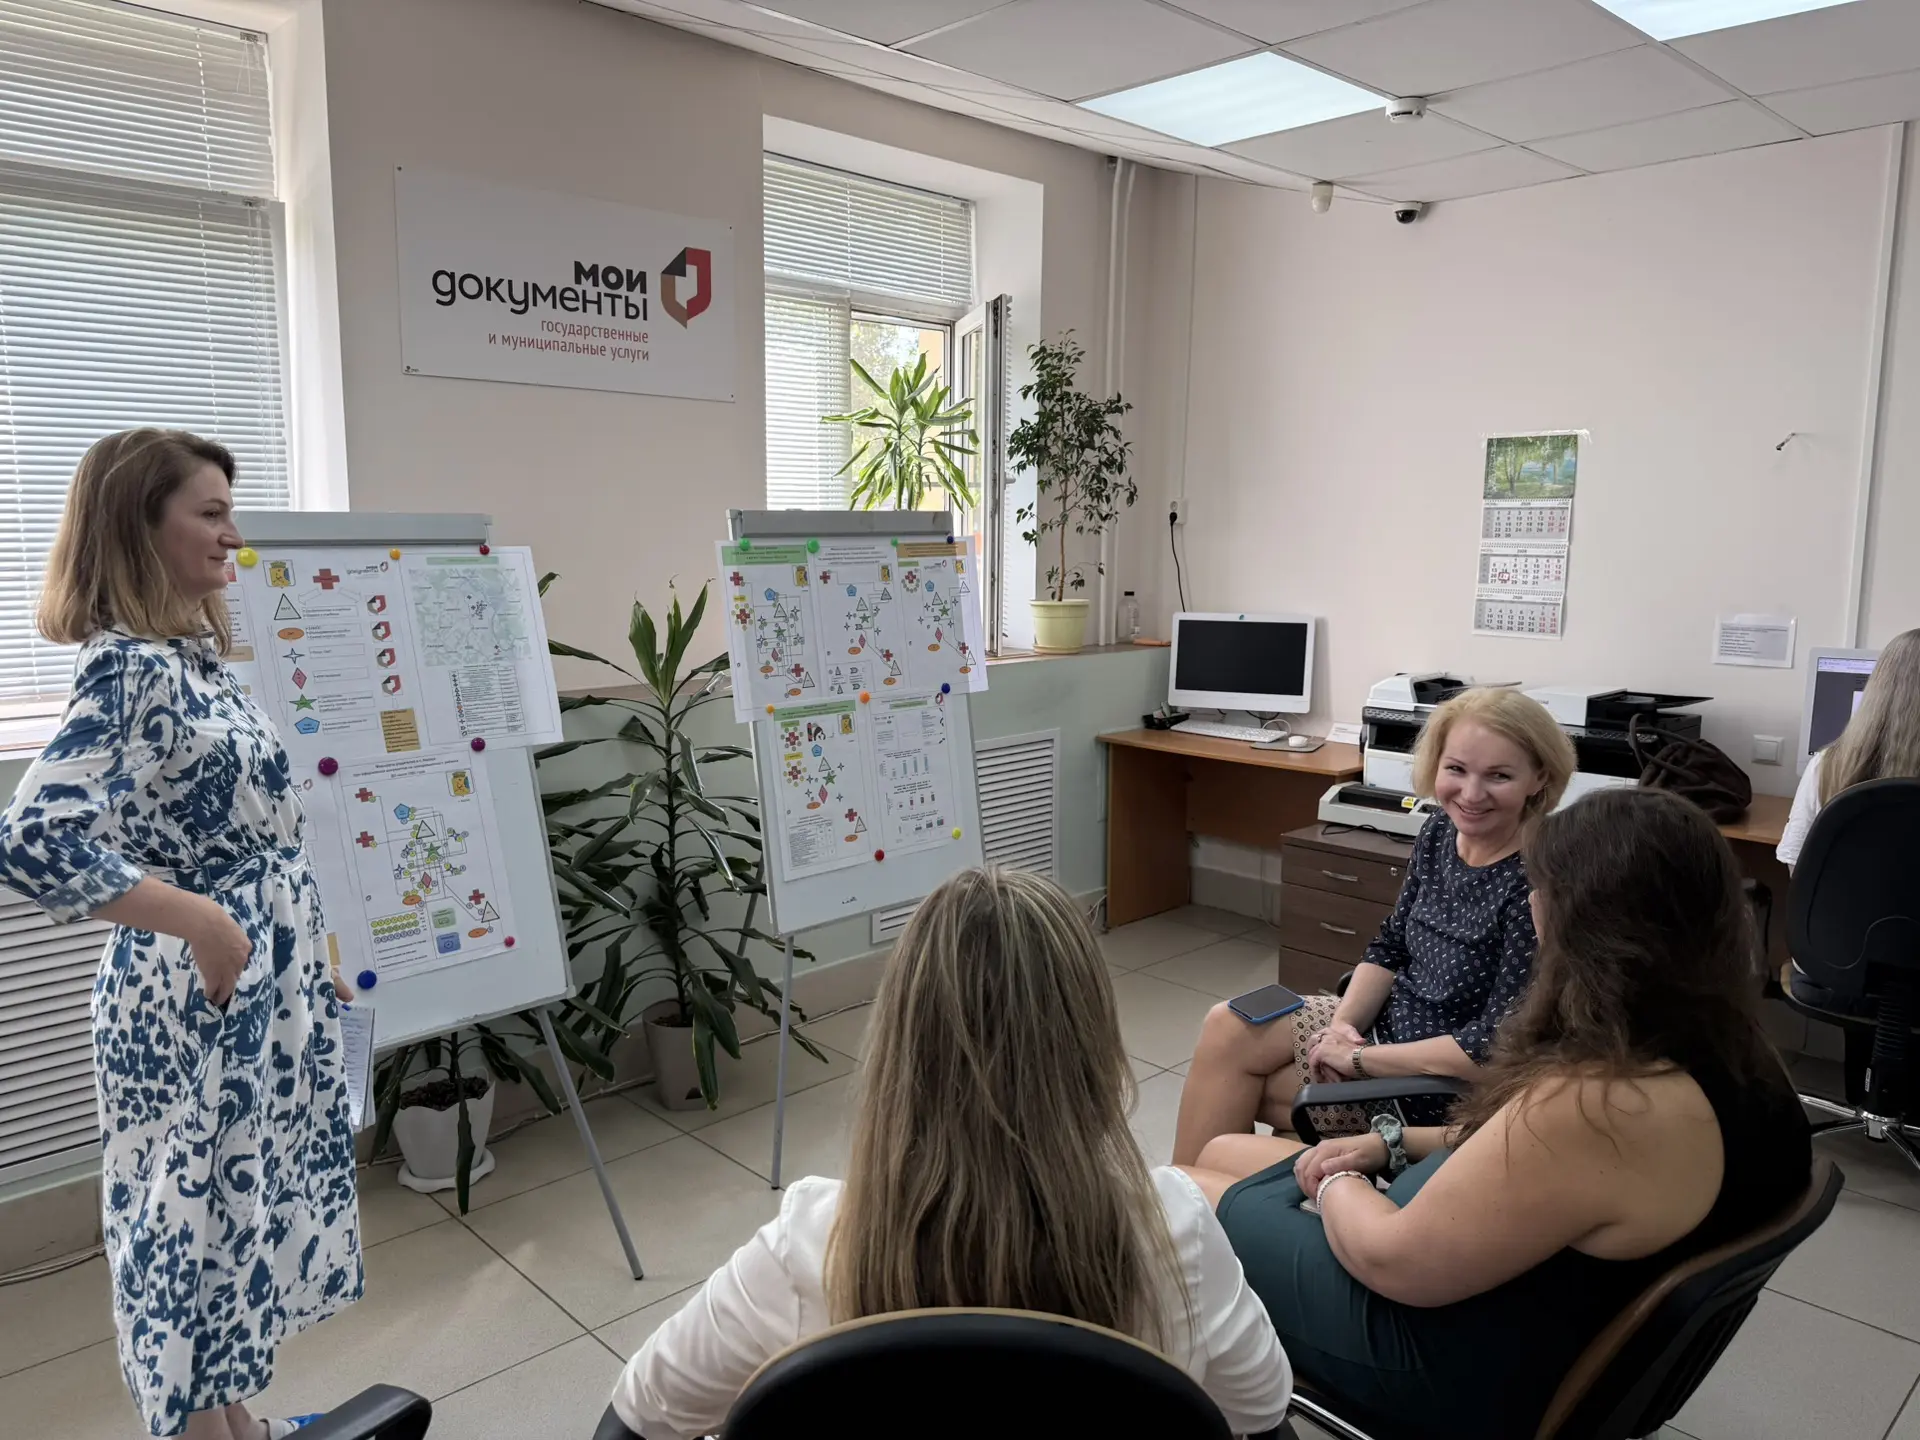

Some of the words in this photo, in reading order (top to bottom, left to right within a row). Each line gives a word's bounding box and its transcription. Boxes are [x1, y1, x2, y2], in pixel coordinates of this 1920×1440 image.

[574, 260, 648, 294] мои
[432, 269, 648, 321] документы
[541, 319, 649, 344] государственные
[488, 333, 497, 345] и
[501, 334, 607, 357] муниципальные
[610, 346, 650, 363] услуги
